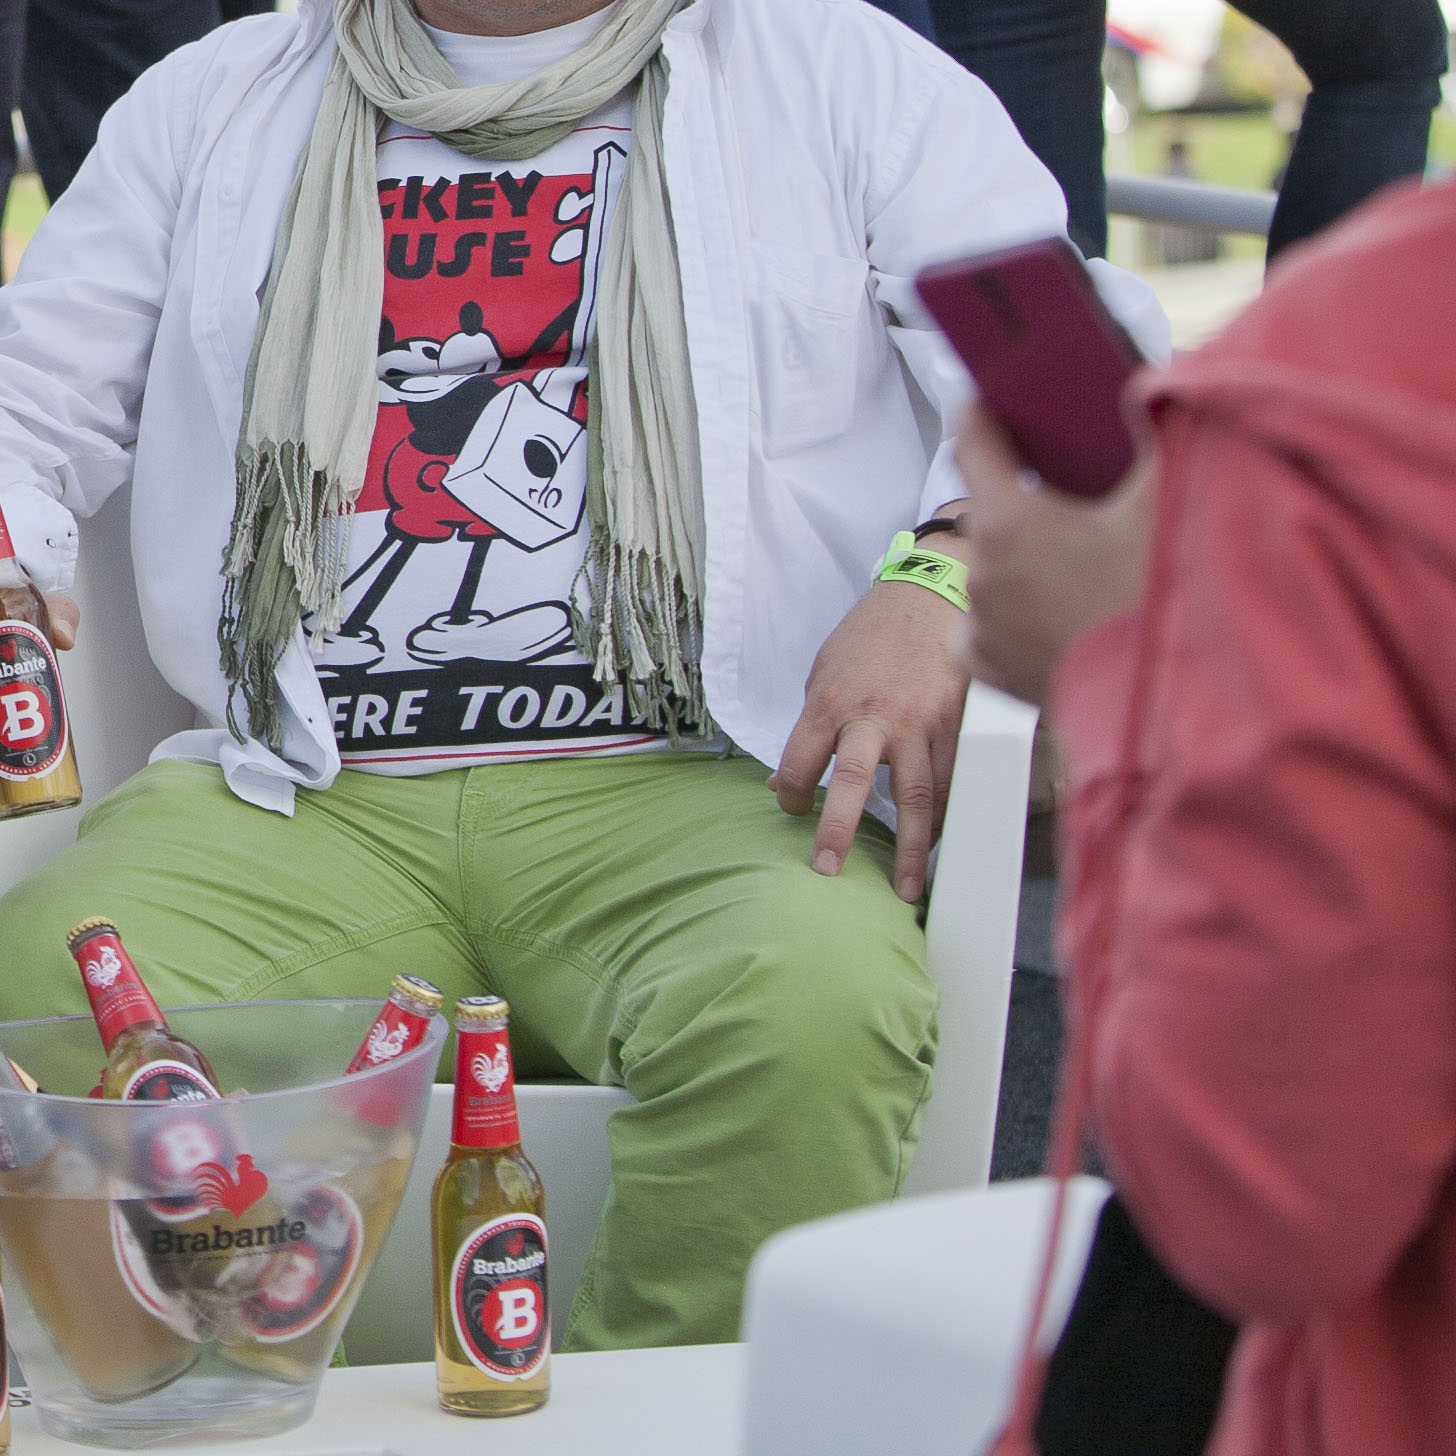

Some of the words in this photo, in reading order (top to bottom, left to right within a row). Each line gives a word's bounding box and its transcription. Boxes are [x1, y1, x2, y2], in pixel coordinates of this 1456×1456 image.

[376, 170, 544, 223] CKEY
[387, 230, 531, 280] USE
[2, 691, 45, 742] B
[327, 689, 429, 739] ERE
[149, 1218, 307, 1256] Brabante
[472, 1250, 546, 1276] Brabante
[494, 1287, 538, 1340] B
